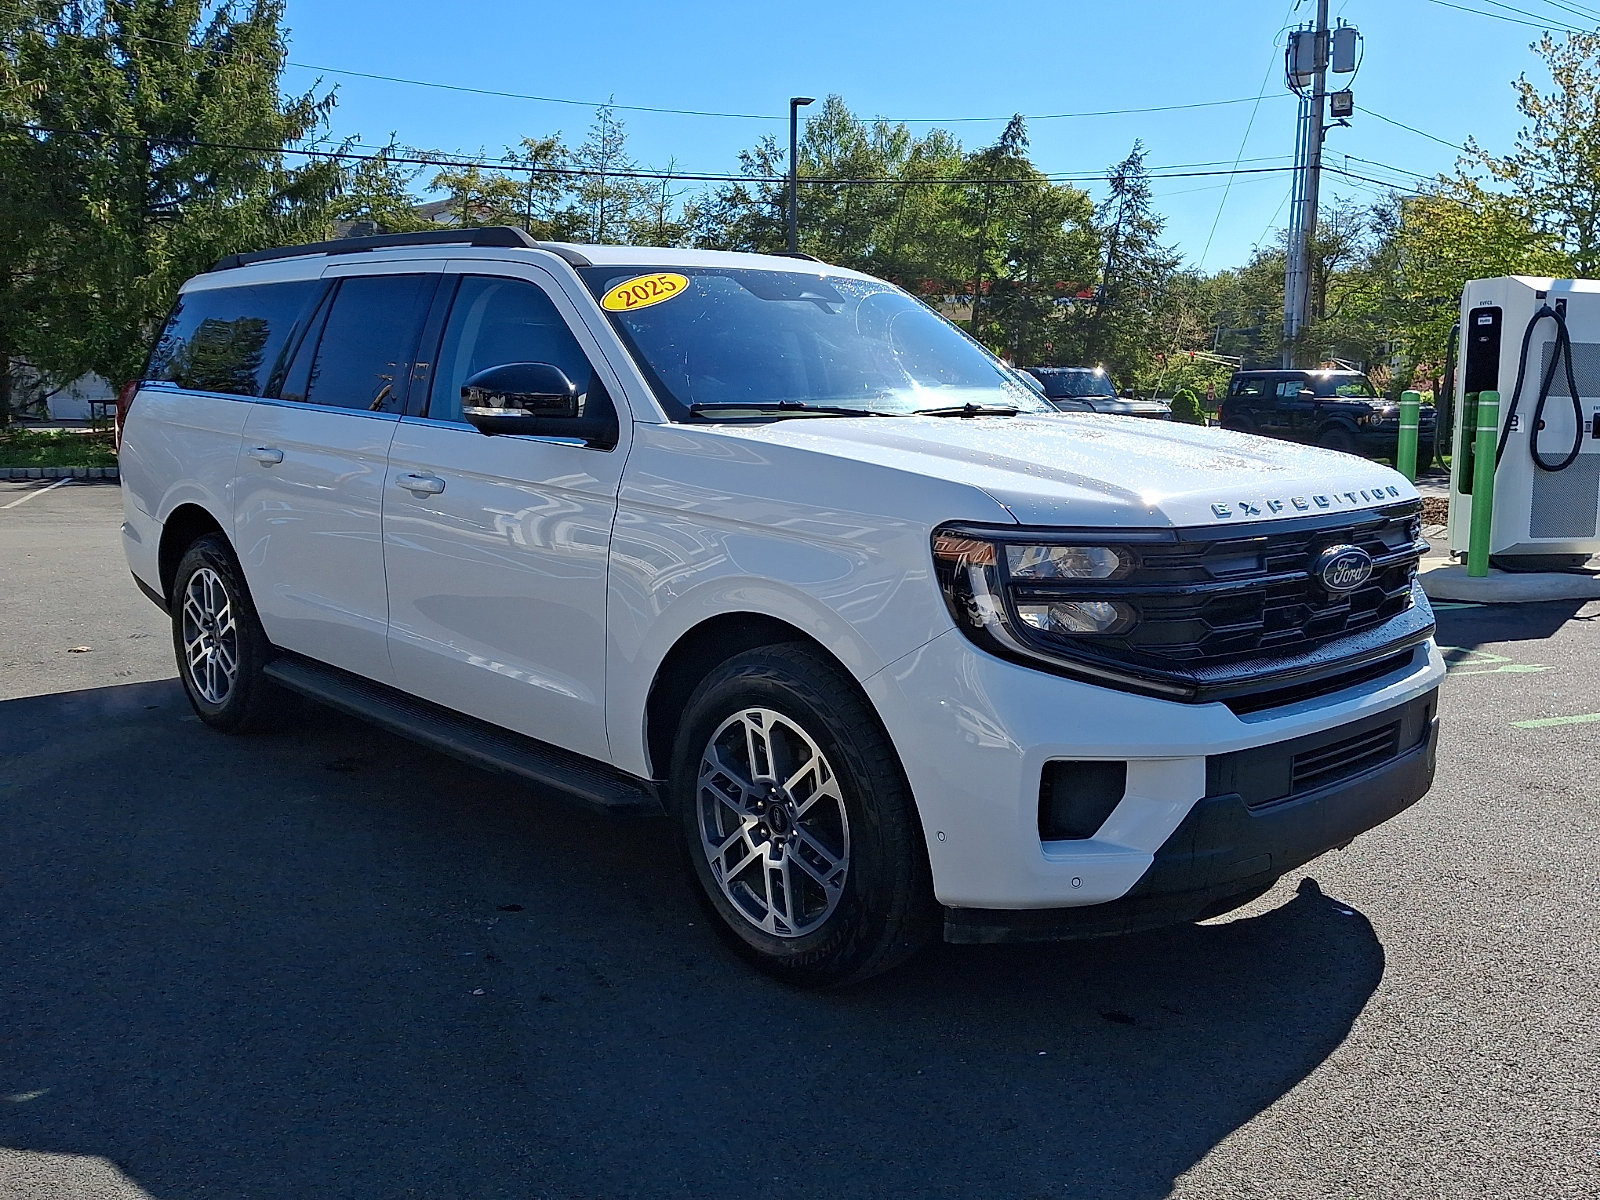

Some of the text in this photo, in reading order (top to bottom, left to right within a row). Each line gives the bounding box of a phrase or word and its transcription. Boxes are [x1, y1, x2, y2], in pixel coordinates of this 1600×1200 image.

[618, 276, 677, 307] 2025
[1211, 485, 1400, 518] EXPEDITION
[1333, 557, 1364, 585] Ford
